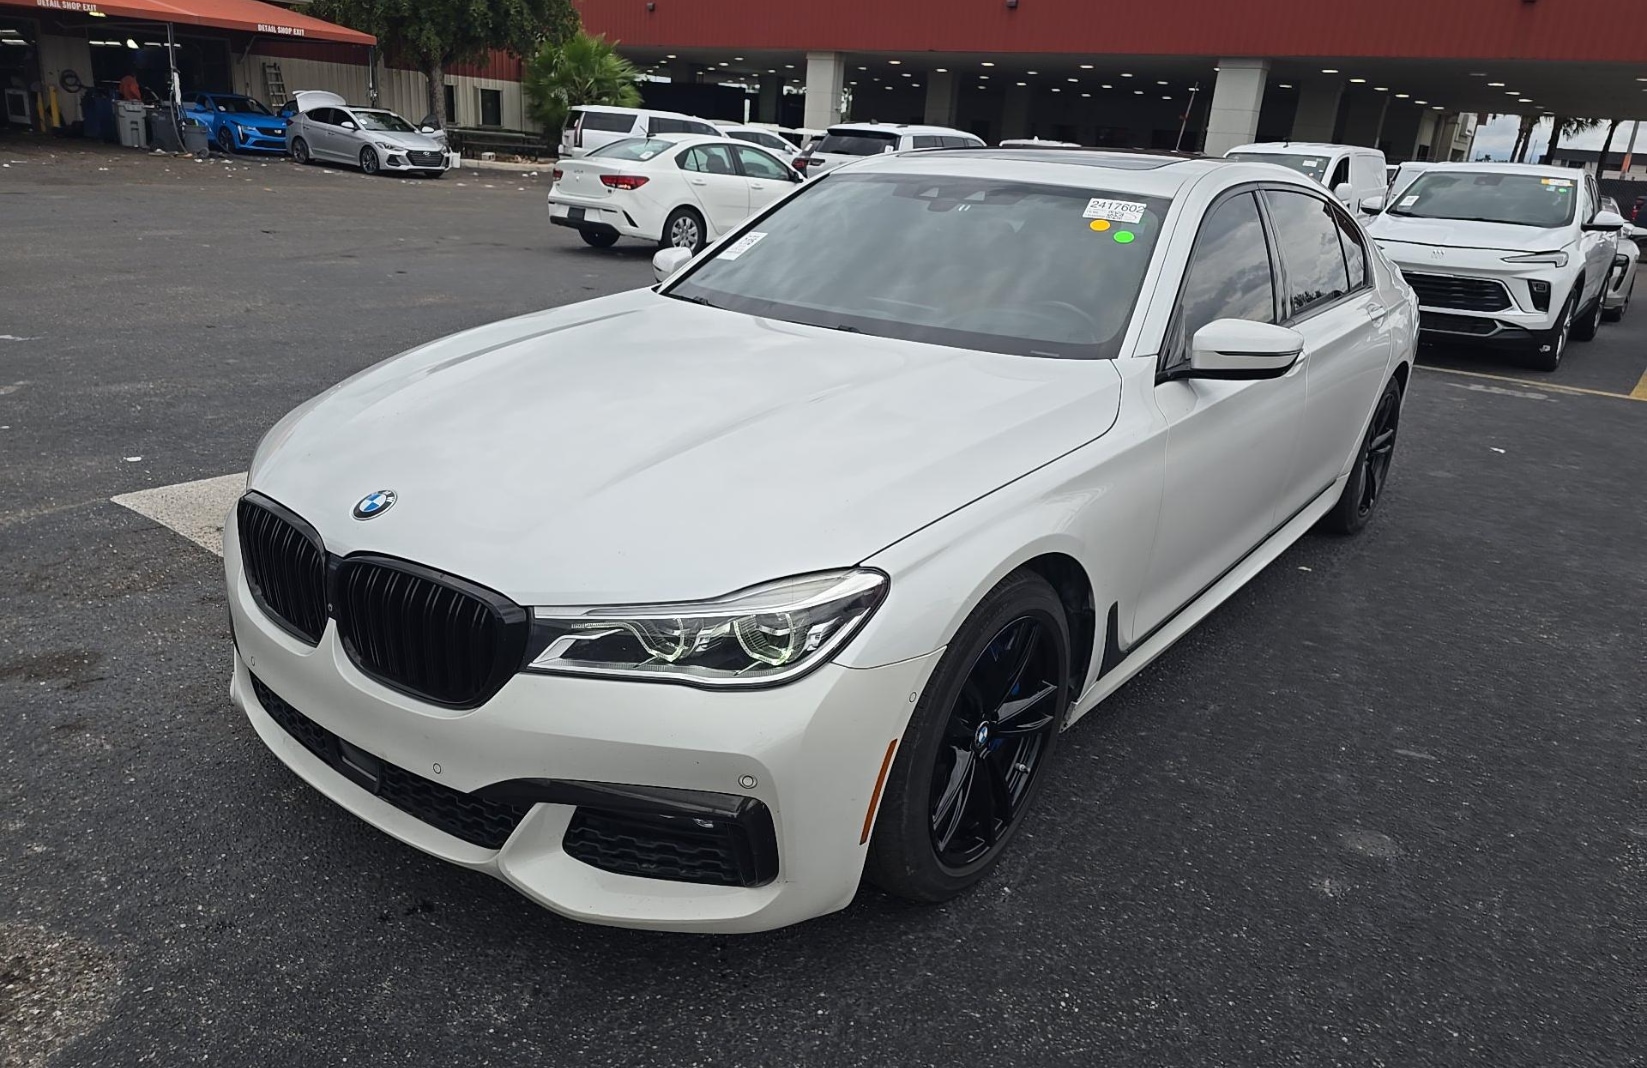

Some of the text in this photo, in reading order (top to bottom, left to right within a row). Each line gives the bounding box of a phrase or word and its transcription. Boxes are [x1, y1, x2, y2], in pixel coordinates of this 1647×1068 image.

[37, 0, 97, 11] DETAIL SHOP EXIT
[257, 24, 276, 33] DETAIL
[1090, 201, 1145, 213] 2417602
